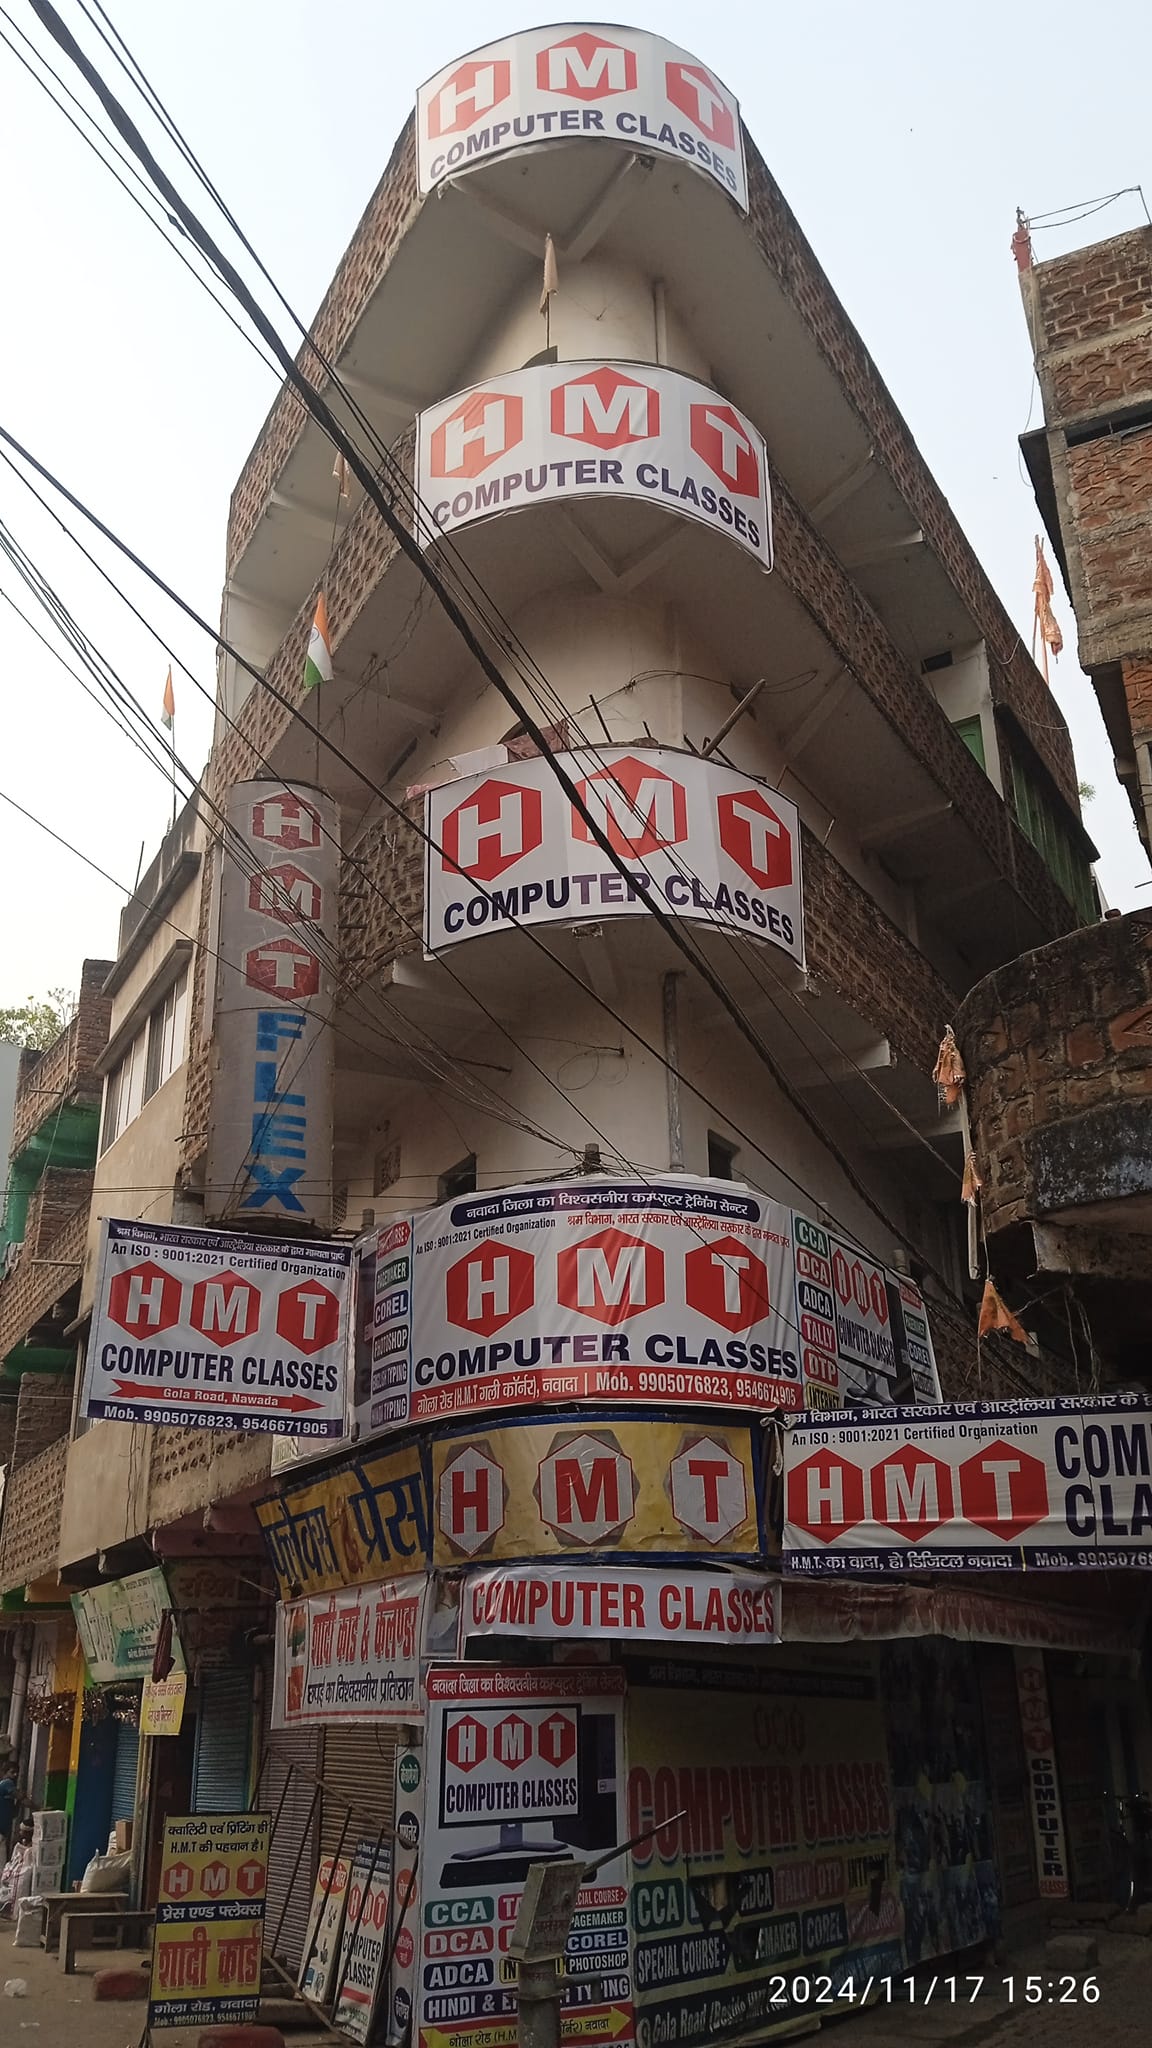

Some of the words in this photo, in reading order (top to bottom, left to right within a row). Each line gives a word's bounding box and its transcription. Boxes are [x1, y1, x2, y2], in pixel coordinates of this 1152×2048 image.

[431, 109, 605, 180] COMPUTER
[615, 112, 738, 193] CLASSES
[432, 459, 624, 528] COMPUTER
[636, 463, 760, 548] CLASSES
[444, 872, 651, 933] COMPUTER
[665, 874, 794, 946] CLASSES
[239, 1011, 307, 1214] FLEX
[466, 1202, 499, 1219] नवादा
[502, 1197, 534, 1213] जिला
[537, 1195, 556, 1208] का
[559, 1190, 628, 1206] विश्वसनीय
[685, 1192, 717, 1210] ट्रेनिंग
[719, 1198, 749, 1215] सेन्टर
[617, 1213, 639, 1225] भारत
[641, 1213, 669, 1225] सरकार
[670, 1212, 682, 1227] एवं
[424, 1241, 434, 1253] ISO
[437, 1230, 471, 1249] 9001:2021
[473, 1225, 505, 1240] Certified
[506, 1217, 556, 1235] Organization
[799, 1222, 826, 1254] CCA
[111, 1242, 127, 1254] An
[130, 1243, 151, 1257] ISO
[162, 1248, 224, 1266] 9001:2021
[229, 1256, 278, 1271] Certified
[281, 1260, 346, 1281] Organization
[799, 1252, 828, 1285] DCA
[375, 1295, 408, 1322] COREL
[803, 1281, 832, 1317] ADCA
[804, 1317, 833, 1348] TALLY
[101, 1344, 234, 1383] COMPUTER
[242, 1356, 338, 1392] CLASSES
[415, 1333, 629, 1386] COMPUTER
[645, 1334, 798, 1380] CLASSES
[808, 1351, 837, 1384] DTP
[163, 1387, 190, 1400] Gola
[194, 1389, 228, 1404] Road,
[232, 1392, 279, 1407] Nawada
[417, 1391, 438, 1414] गोला
[439, 1389, 453, 1409] रोड
[479, 1380, 501, 1400] गली
[542, 1376, 578, 1393] नवादा
[596, 1371, 633, 1392] Mob.
[639, 1373, 733, 1400] 9905076823,
[810, 1409, 858, 1423] विभाग,
[862, 1406, 898, 1420] भारत
[901, 1403, 951, 1418] सरकार
[954, 1399, 978, 1415] एवं
[981, 1398, 1055, 1417] आस्ट्रेलिया
[1119, 1391, 1139, 1407] के
[103, 1404, 139, 1421] Mob.
[143, 1410, 238, 1430] 9905076823,
[242, 1416, 328, 1435] 9546671905
[792, 1433, 806, 1446] An
[809, 1431, 829, 1444] ISO
[839, 1429, 899, 1443] 9001:2021
[904, 1425, 955, 1440] Certified
[959, 1422, 1038, 1440] Organization
[825, 1555, 846, 1569] का
[849, 1554, 885, 1571] वादा,
[888, 1551, 904, 1570] हो
[906, 1550, 965, 1569] डिजिटल
[967, 1553, 1013, 1569] नवादा
[1035, 1551, 1074, 1568] Mob.
[472, 1580, 646, 1628] COMPUTER
[659, 1584, 775, 1633] CLASSES
[432, 1677, 457, 1695] नवादा
[480, 1676, 494, 1693] का
[446, 1781, 519, 1813] COMPUTER
[522, 1778, 577, 1807] CLASSES
[628, 1766, 798, 1864] COMPUTER
[801, 1760, 891, 1845] CLASSES
[1031, 1758, 1064, 1876] COMPUTER
[168, 1821, 207, 1837] क्वालिटी
[209, 1822, 226, 1835] एवं
[256, 1820, 269, 1834] ही
[170, 1840, 197, 1854] H.M.T
[199, 1839, 213, 1853] की
[215, 1841, 249, 1854] पहचान
[637, 1884, 680, 1926] CCA
[817, 1861, 842, 1896] DTP
[162, 1904, 185, 1922] प्रेस
[188, 1905, 216, 1919] एण्ड
[218, 1901, 263, 1918] फ्लेक्स
[431, 1901, 487, 1924] CCA
[158, 1925, 211, 1988] शादी
[217, 1921, 261, 1986] कार्ड
[429, 1930, 489, 1954] DCA
[567, 1931, 627, 1951] COREL
[638, 1942, 679, 1984] SPECIAL
[806, 1910, 843, 1949] COREL
[429, 1963, 489, 1988] ADCA
[569, 1953, 627, 1973] PHOTOSHOP
[154, 2002, 187, 2014] गोला
[428, 1995, 476, 2019] HINDI
[482, 1993, 496, 2011] &
[680, 2003, 707, 2038] Road
